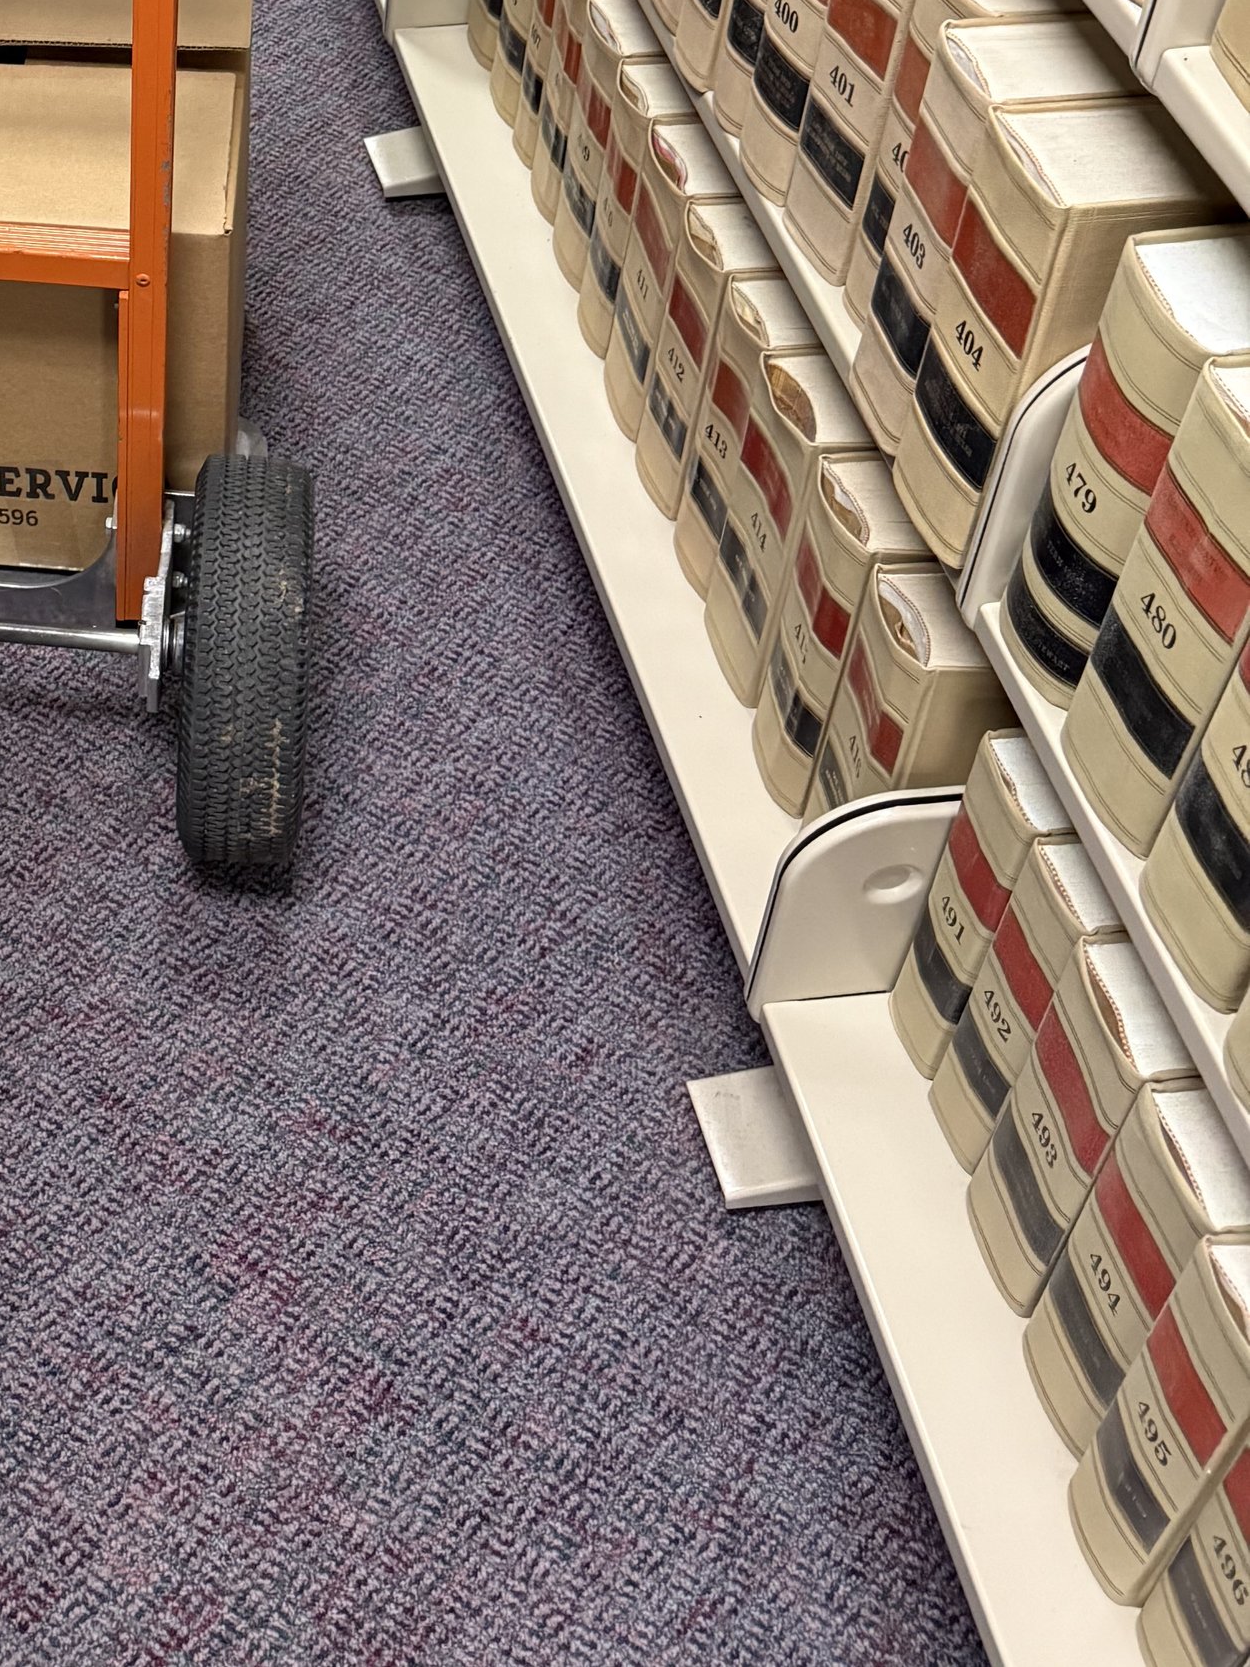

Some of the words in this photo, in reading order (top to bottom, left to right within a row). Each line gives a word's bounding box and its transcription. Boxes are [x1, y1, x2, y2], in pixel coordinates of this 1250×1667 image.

[829, 65, 854, 108] 401
[903, 224, 926, 269] 403
[667, 346, 685, 383] 412
[955, 319, 984, 372] 404
[704, 423, 729, 460] 413
[1065, 462, 1097, 514] 479
[750, 511, 767, 554] 414
[1140, 592, 1178, 650] 480
[940, 895, 965, 946] 491
[983, 989, 1012, 1044] 492
[1031, 1112, 1058, 1169] 493
[1089, 1252, 1121, 1317] 494
[1136, 1400, 1173, 1467] 495
[1211, 1534, 1249, 1607] 496
